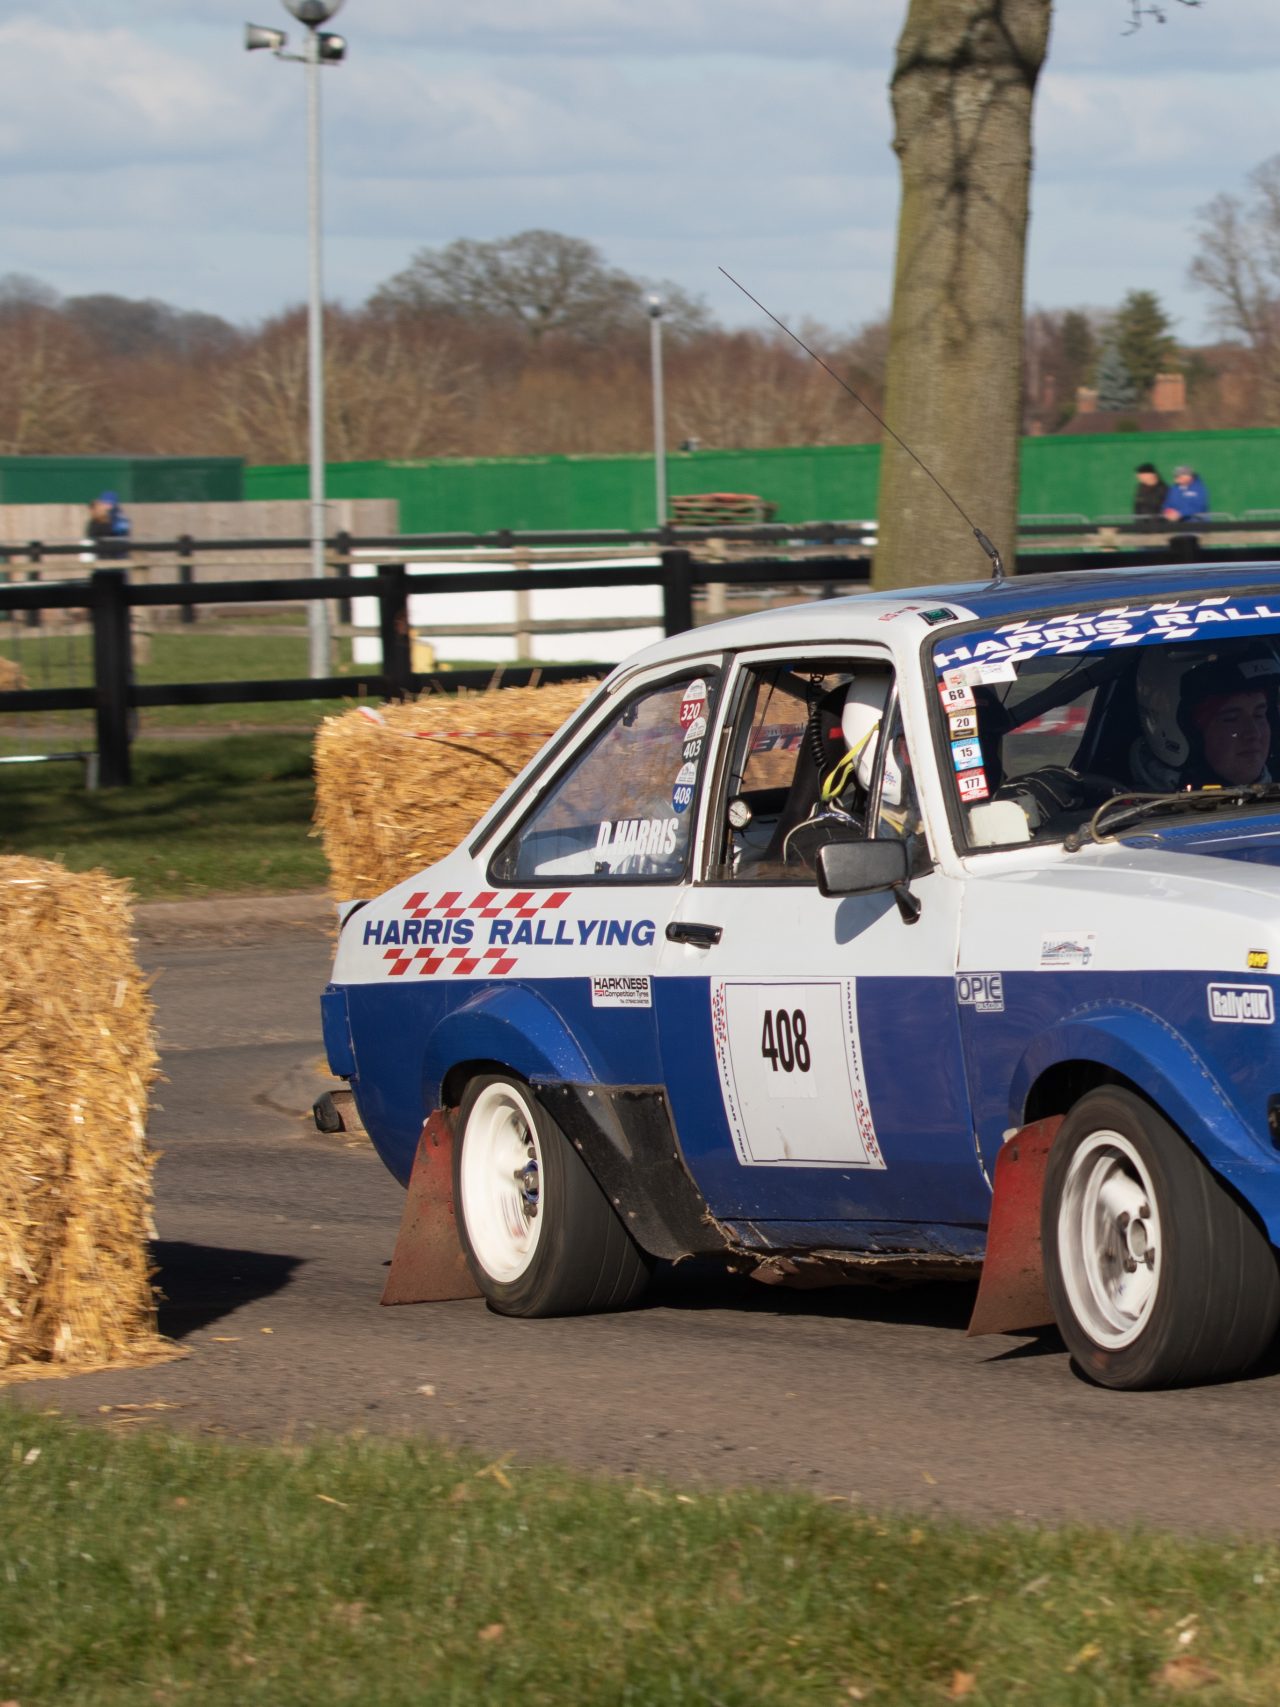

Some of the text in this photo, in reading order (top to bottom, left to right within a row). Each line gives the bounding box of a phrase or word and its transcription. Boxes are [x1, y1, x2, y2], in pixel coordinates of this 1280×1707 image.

[933, 619, 1133, 668] HARRIS
[948, 688, 965, 701] 68
[680, 702, 701, 721] 320
[956, 718, 970, 728] 20
[683, 740, 702, 758] 403
[960, 747, 973, 758] 15
[964, 777, 980, 789] 177
[673, 786, 691, 804] 408
[363, 919, 656, 946] HARRIS RALLYING
[594, 977, 648, 990] HARKNESS
[958, 976, 1001, 1001] OPIE
[761, 1008, 811, 1073] 408
